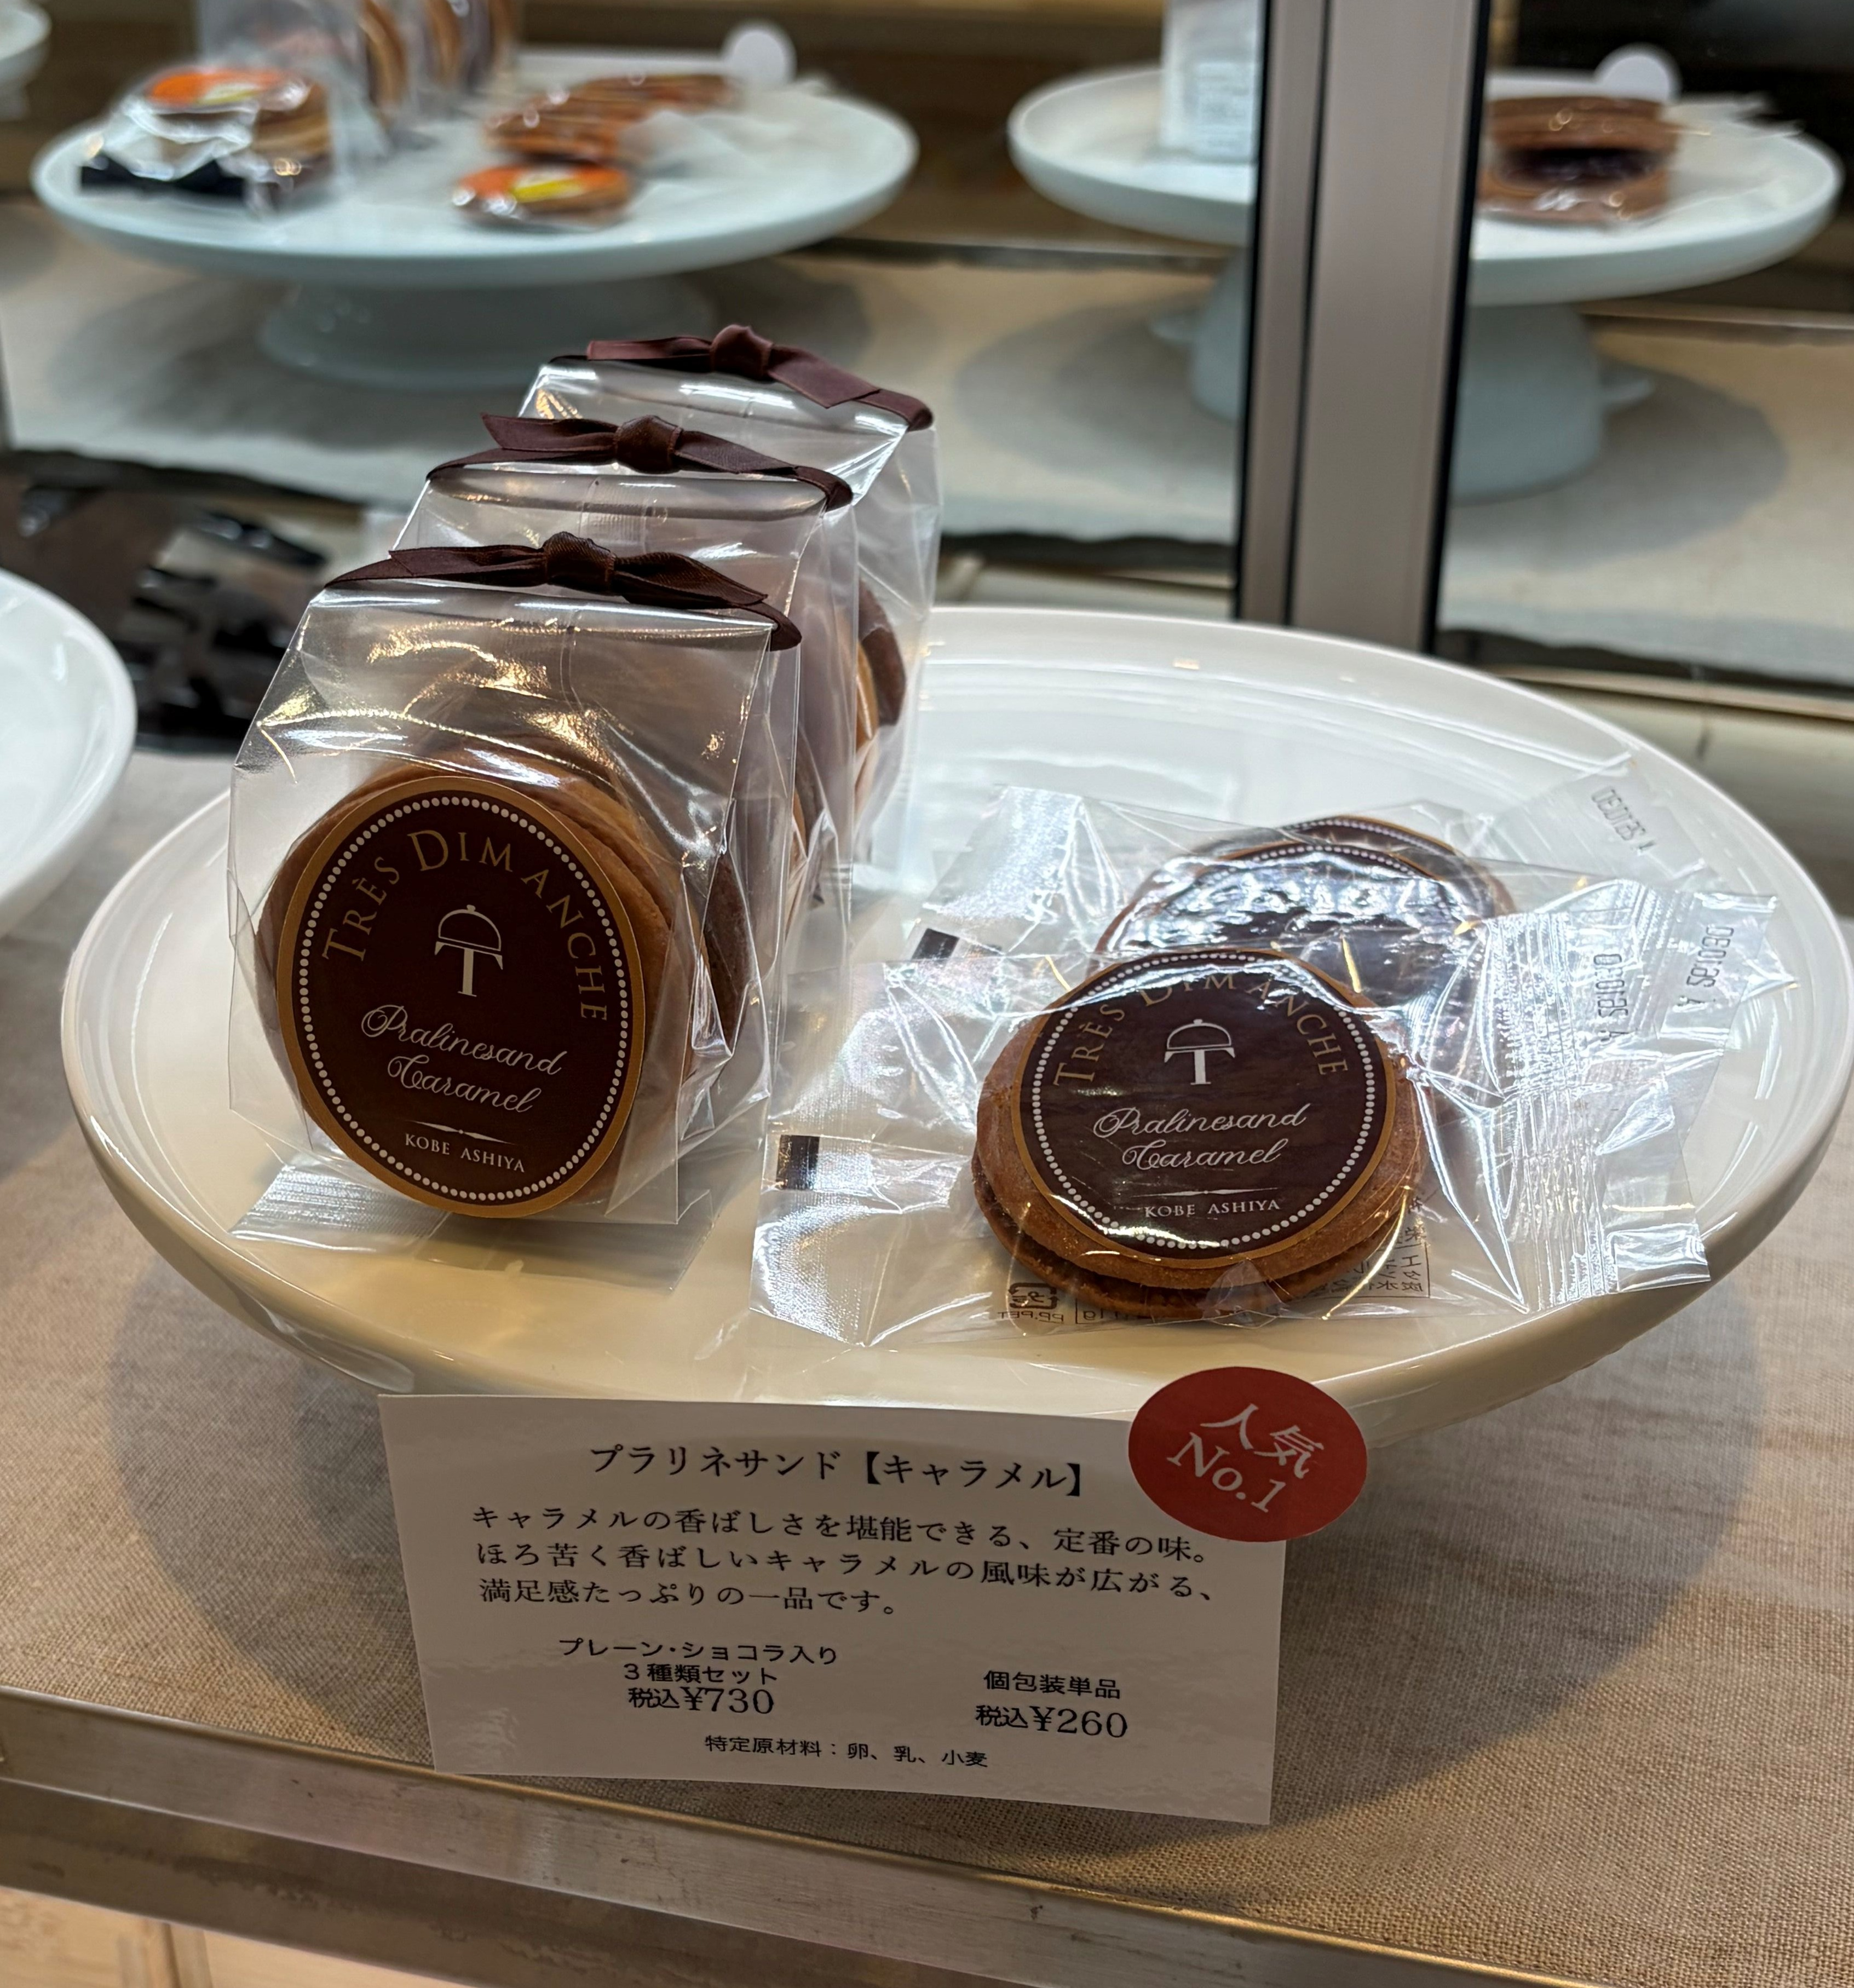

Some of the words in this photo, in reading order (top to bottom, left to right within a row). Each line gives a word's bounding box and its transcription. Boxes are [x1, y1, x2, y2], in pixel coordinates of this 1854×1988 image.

[322, 856, 400, 961] TRÈS
[407, 829, 607, 1021] DIMANCHE
[361, 1004, 567, 1075] Pralinesand
[1053, 1004, 1125, 1086] TRÈS
[388, 1054, 542, 1113] Caramel
[1093, 1103, 1311, 1139] Pralinesand
[405, 1133, 450, 1155] KOBE
[460, 1147, 525, 1173] ASHIYA
[1122, 1138, 1289, 1171] Caramel
[1144, 1204, 1196, 1218] KOBE
[1208, 1199, 1281, 1215] ASHIYA
[1200, 1403, 1324, 1478] 人気
[591, 1443, 1081, 1497] プラリネサンド【キャラメル】
[1166, 1432, 1286, 1513] No.1
[473, 1507, 1206, 1563] キャラメルの香ばしさを堪能できる、定番の味。
[477, 1543, 1211, 1601] ほろ苦く香ばしいキャラメルの風味が広がる、
[479, 1578, 894, 1615] 満足感たっぷりの一品です。
[559, 1638, 837, 1665] プレーン・ショコラ入り
[983, 1670, 1120, 1699] 個包装単品
